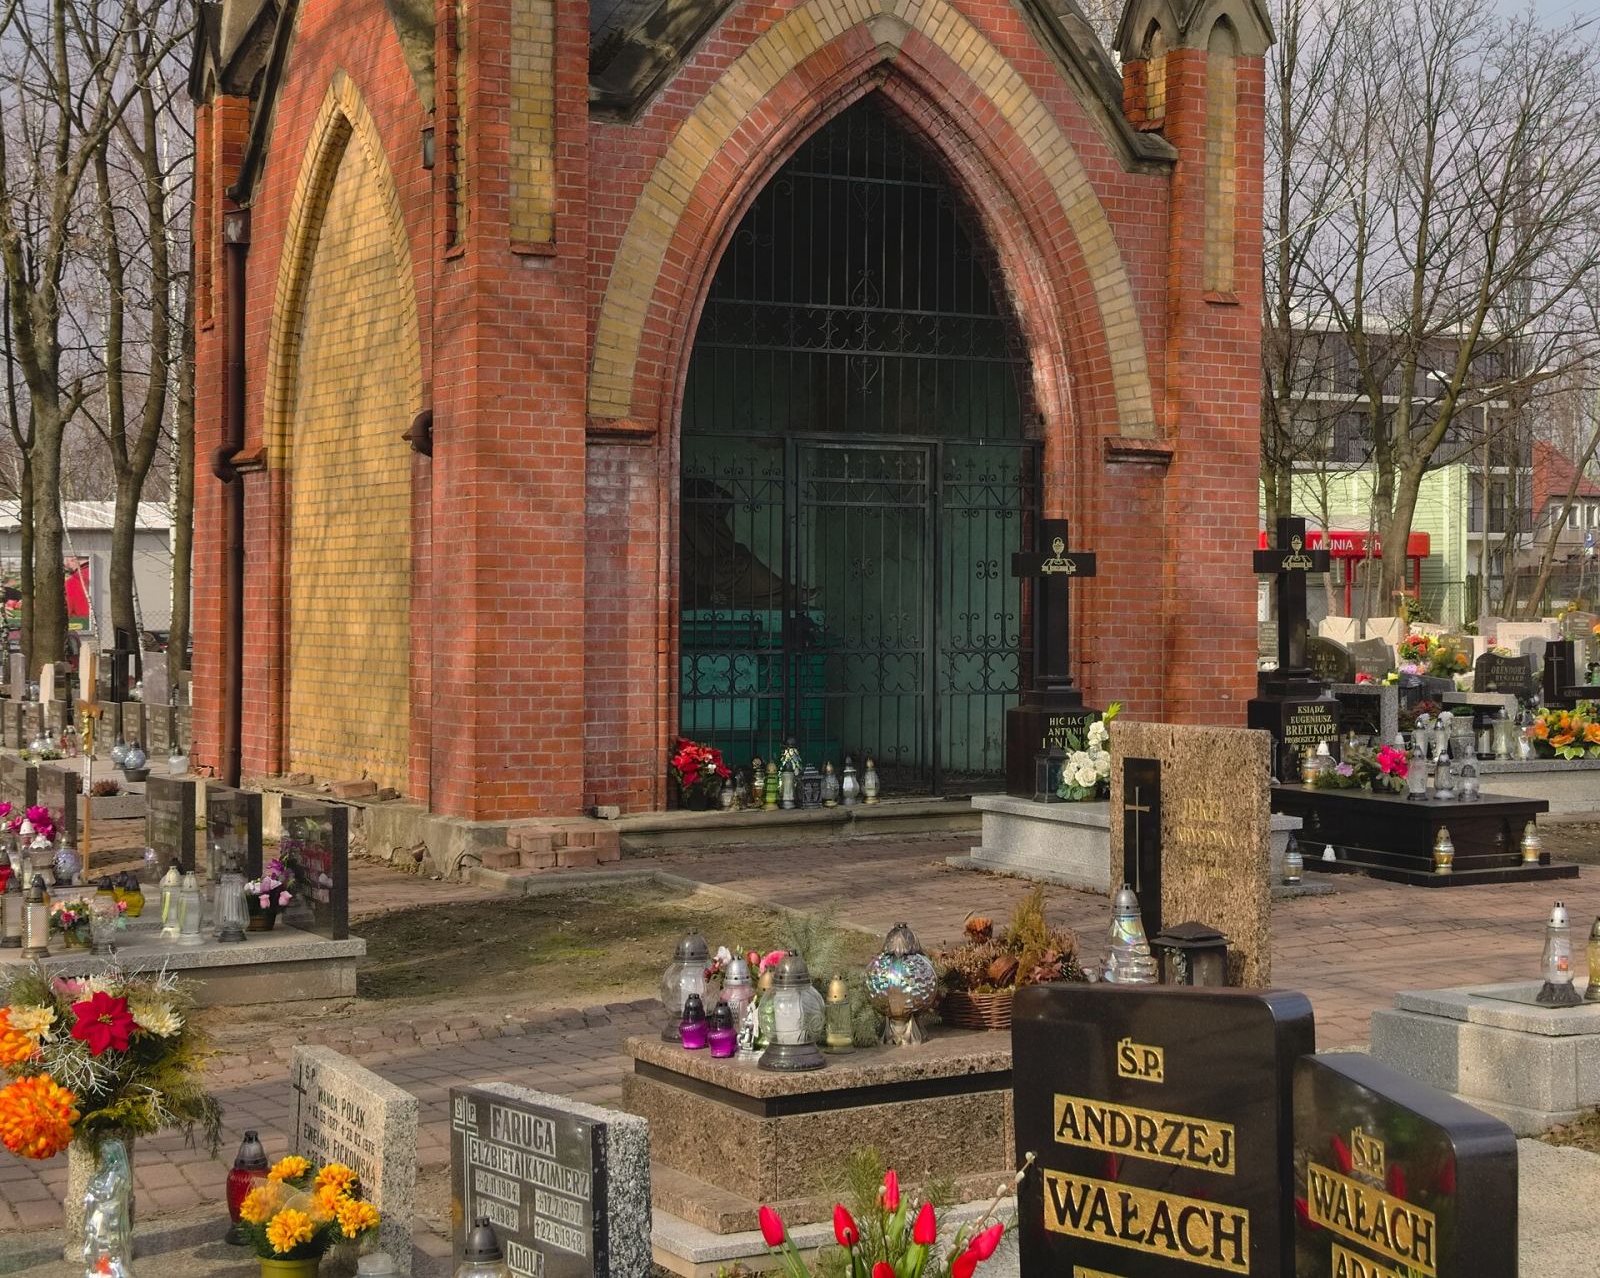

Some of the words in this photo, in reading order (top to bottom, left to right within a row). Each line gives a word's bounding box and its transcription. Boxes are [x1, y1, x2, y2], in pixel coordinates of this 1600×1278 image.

[1362, 539, 1381, 551] 2h
[1049, 717, 1065, 726] HIC
[1290, 715, 1332, 724] EUGENIUSZ
[1297, 705, 1325, 715] KSIĄDZ
[1286, 724, 1337, 736] BREITKOPF
[341, 1098, 366, 1131] POLAK
[492, 1106, 555, 1156] FARUGA
[1056, 1102, 1233, 1170] ANDRZEJ
[525, 1155, 589, 1197] KAZIMIERZ
[1046, 1176, 1247, 1267] WAŁACH
[1309, 1168, 1435, 1269] WAŁACH
[508, 1243, 542, 1277] ADOLF
